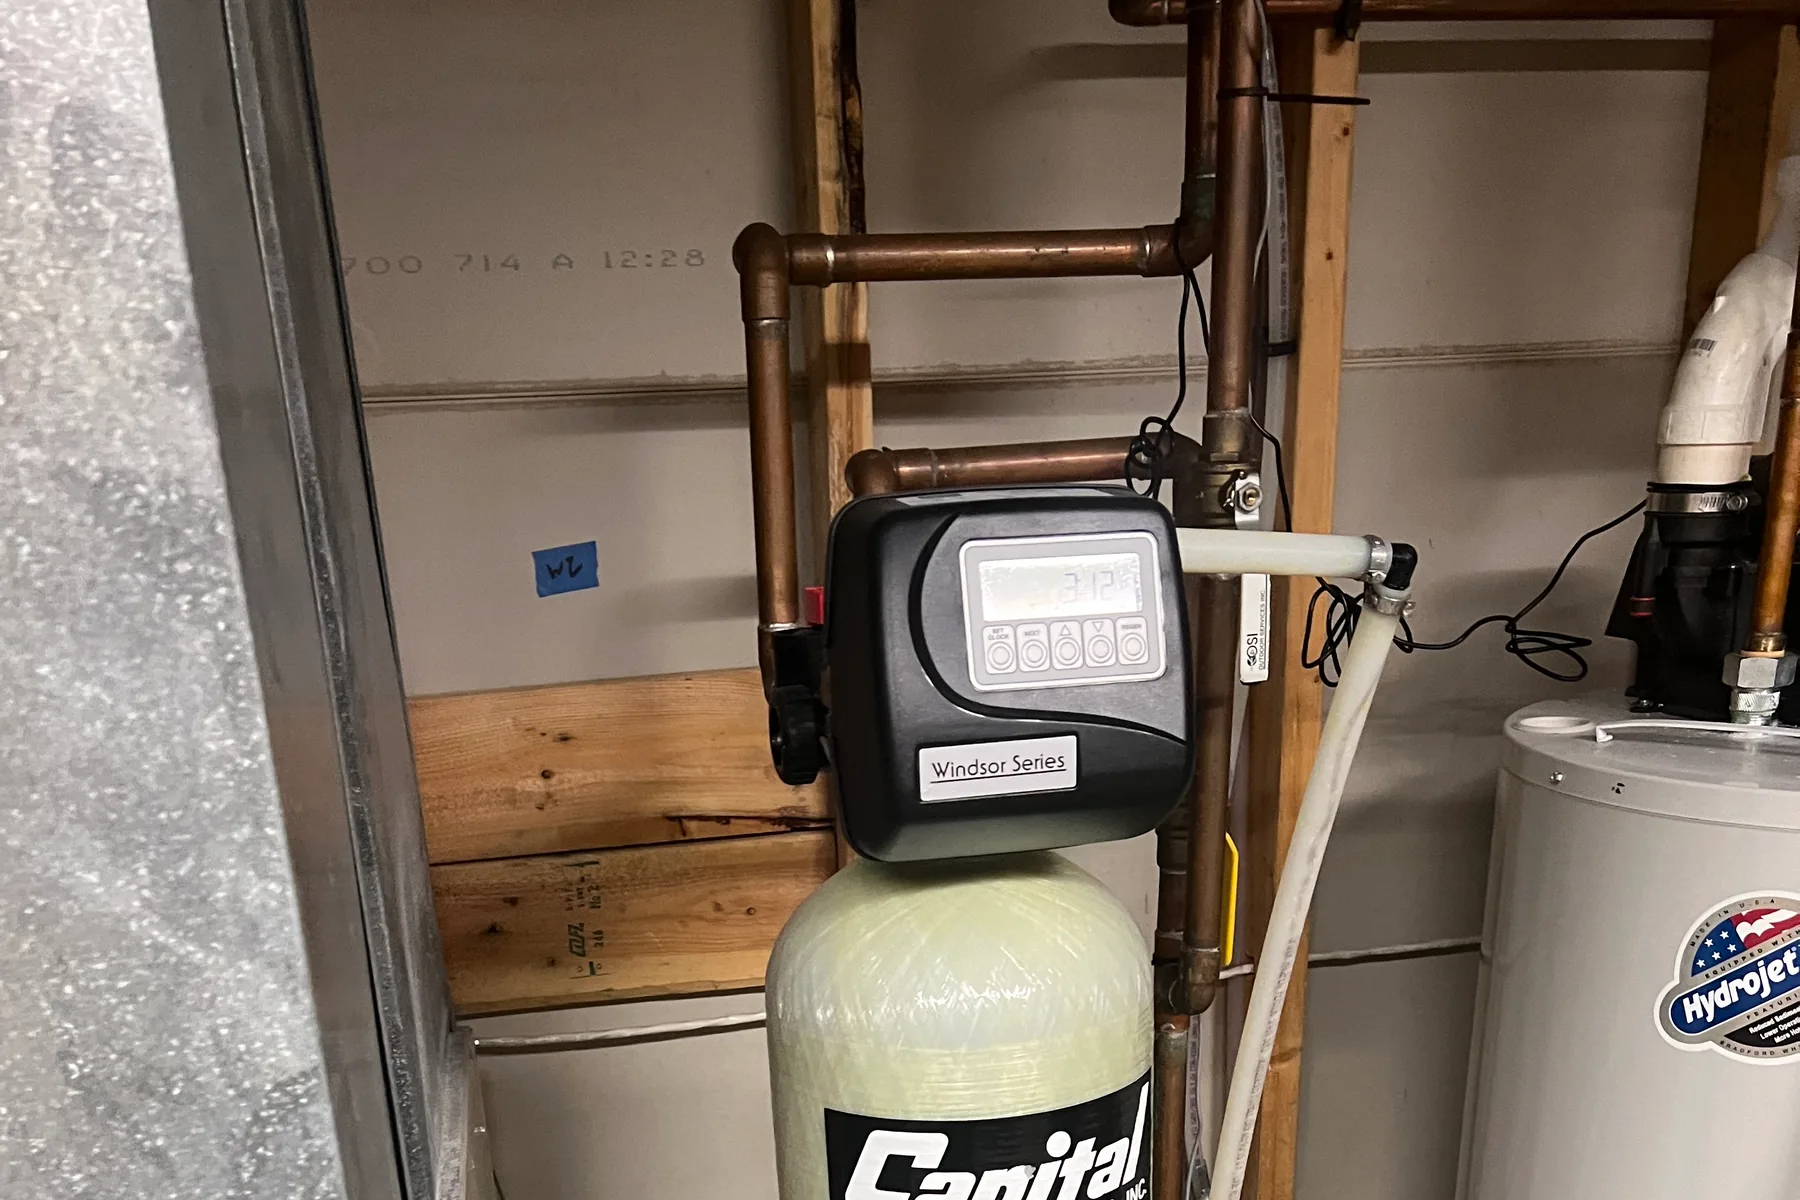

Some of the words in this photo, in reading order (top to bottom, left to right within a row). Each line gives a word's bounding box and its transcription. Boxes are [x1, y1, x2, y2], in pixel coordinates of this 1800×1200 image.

[454, 253, 521, 272] 714
[551, 252, 576, 270] A
[602, 248, 706, 270] 12:28
[931, 757, 1006, 780] Windsor
[1012, 753, 1065, 773] Series
[1690, 922, 1711, 948] MADE
[1718, 909, 1730, 918] IN
[1705, 948, 1763, 979] EQUIPPED
[1682, 948, 1799, 1024] Hydrojet
[1746, 993, 1800, 1020] FEATURI
[1719, 1039, 1775, 1056] BRADFORD
[1760, 1028, 1779, 1040] Lower
[1774, 1032, 1791, 1044] More
